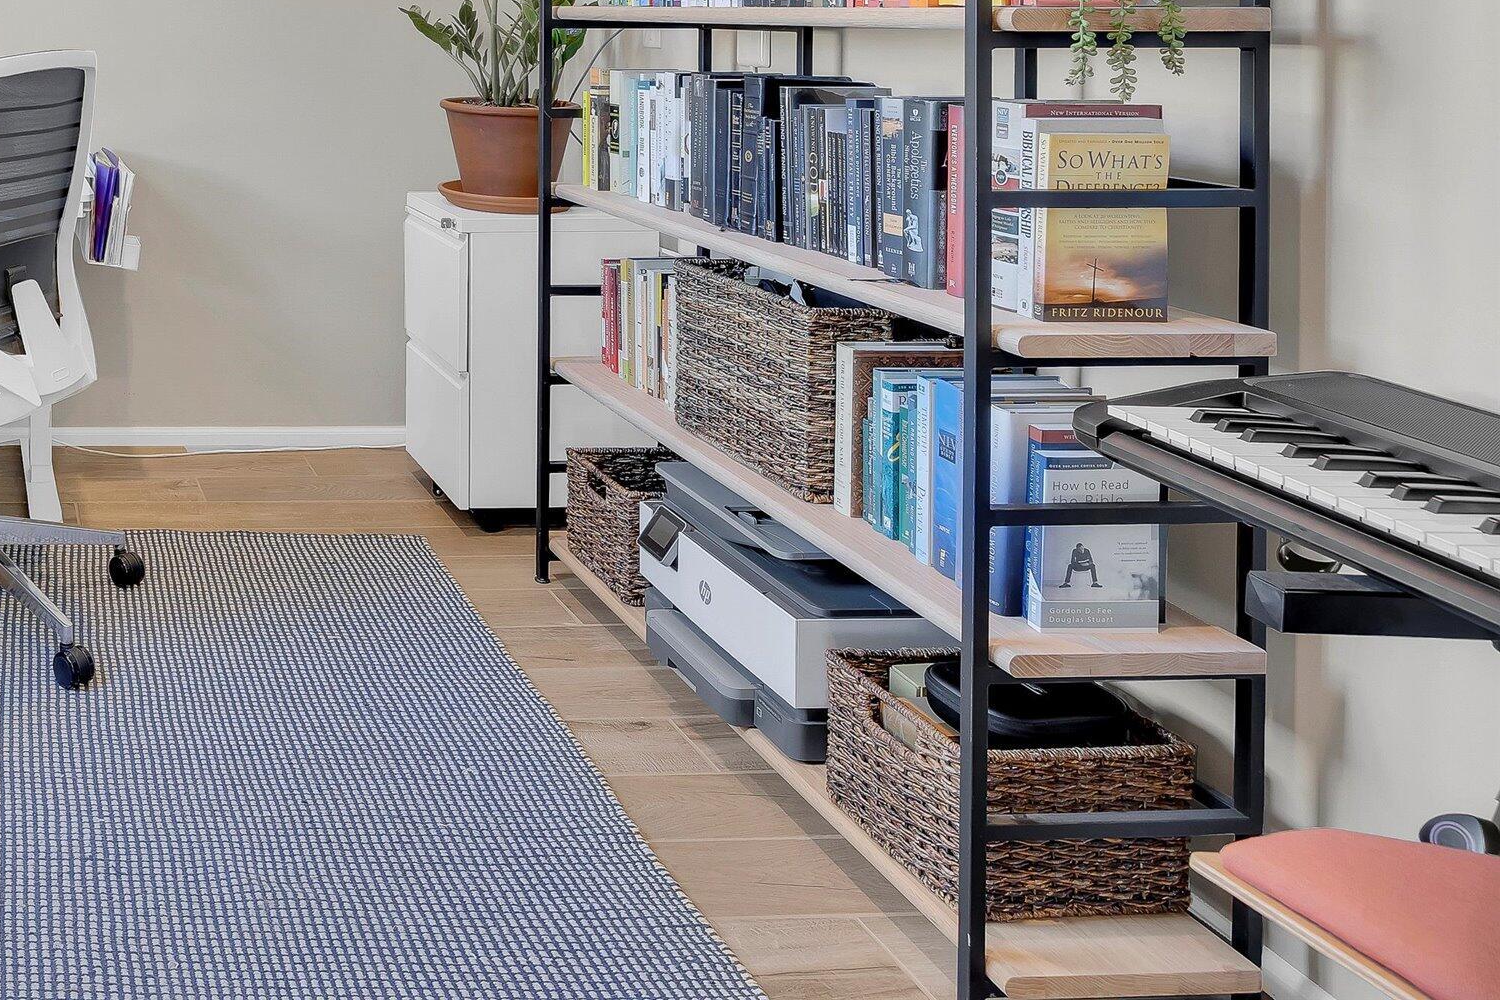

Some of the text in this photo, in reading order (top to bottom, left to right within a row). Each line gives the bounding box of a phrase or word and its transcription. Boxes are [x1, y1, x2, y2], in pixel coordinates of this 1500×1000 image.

[908, 130, 924, 200] Apologetics
[920, 159, 928, 174] The
[1021, 130, 1034, 178] BIBLICAL
[1057, 150, 1163, 170] SO WHAT'S
[808, 152, 819, 194] GOD
[949, 124, 958, 215] EVERYONE'S THEOLOGIAN
[1095, 172, 1122, 180] THE
[889, 164, 897, 211] Background
[1052, 307, 1164, 318] FRITZ RIDENOUR
[920, 406, 928, 456] TIMOTHY
[1052, 479, 1129, 491] How to Read
[917, 485, 926, 535] PRAYER
[699, 580, 712, 605] hp
[1049, 607, 1082, 615] Gordon
[1085, 607, 1095, 615] D.
[1049, 615, 1114, 625] Douglas Stuart
